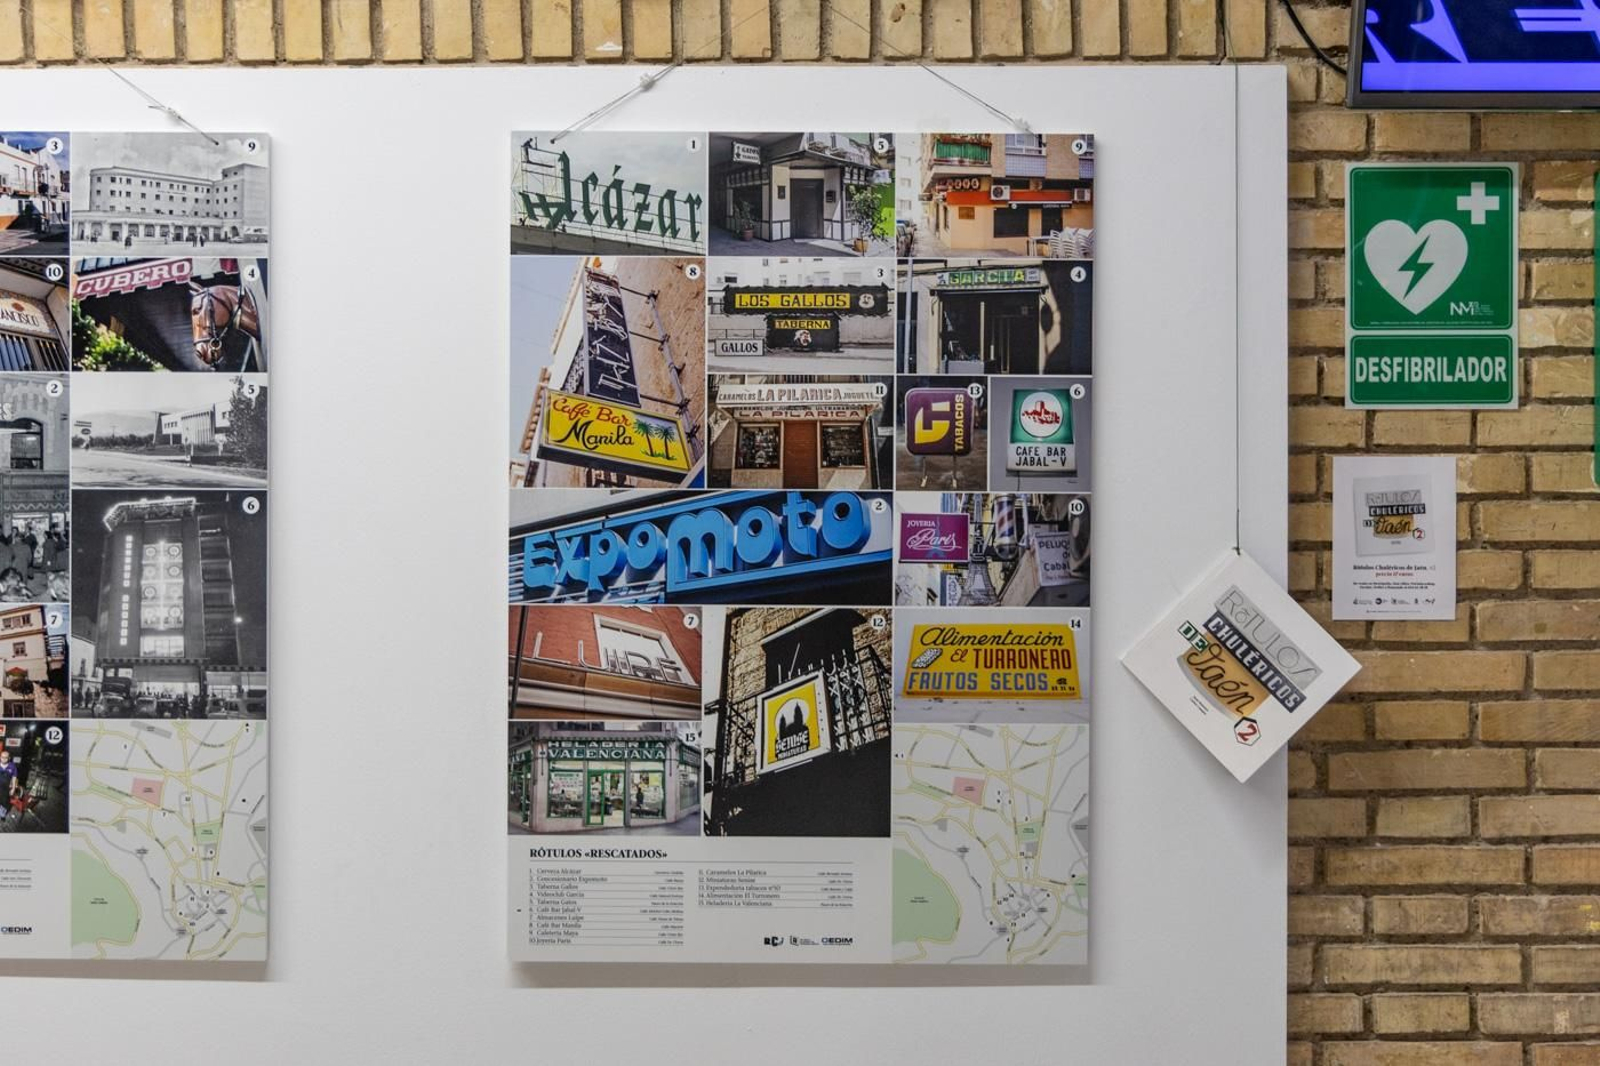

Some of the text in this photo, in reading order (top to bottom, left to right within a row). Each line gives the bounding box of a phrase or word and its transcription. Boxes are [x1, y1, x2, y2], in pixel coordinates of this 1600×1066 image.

[51, 140, 58, 151] 3
[248, 141, 256, 152] 9
[877, 139, 885, 151] 5
[1074, 142, 1083, 152] 9
[48, 267, 61, 278] 10
[247, 267, 256, 279] 4
[688, 267, 697, 277] 8
[877, 268, 884, 278] 3
[1074, 269, 1082, 280] 4
[75, 261, 192, 298] CUBERO
[738, 293, 848, 308] LOS GALLOS
[776, 319, 831, 329] TABERNA
[721, 341, 759, 354] GALLOS
[1354, 356, 1507, 383] DESFIBRILADOR
[51, 383, 58, 394] 2
[247, 384, 255, 395] 5
[757, 388, 776, 402] LA
[777, 387, 843, 401] PILARICA
[875, 385, 885, 395] 11
[970, 386, 981, 395] 13
[1074, 386, 1082, 397] 6
[552, 397, 632, 427] Café Bar
[771, 410, 860, 418] PILARICA
[954, 393, 964, 452] TABACOS
[553, 418, 635, 450] Manila
[1015, 445, 1067, 457] CAFE BAR
[247, 499, 255, 511] 6
[874, 500, 883, 511] 2
[1069, 502, 1083, 513] 10
[51, 614, 58, 625] 7
[688, 616, 695, 627] 7
[872, 616, 885, 628] 12
[1071, 619, 1082, 629] 14
[920, 627, 1065, 647] Alimentación
[1179, 622, 1208, 652] DE
[950, 648, 1072, 670] El TURRONERO
[1207, 616, 1302, 709] CHULÉRICOS
[908, 672, 1048, 691] FRUTOS SECOS
[1187, 643, 1256, 716] Jaén
[48, 730, 61, 741] 12
[685, 733, 696, 742] 15
[1237, 723, 1258, 743] 2
[549, 748, 667, 760] VALENCIANA
[529, 846, 668, 859] RÓTULOS «RESCATADOS»
